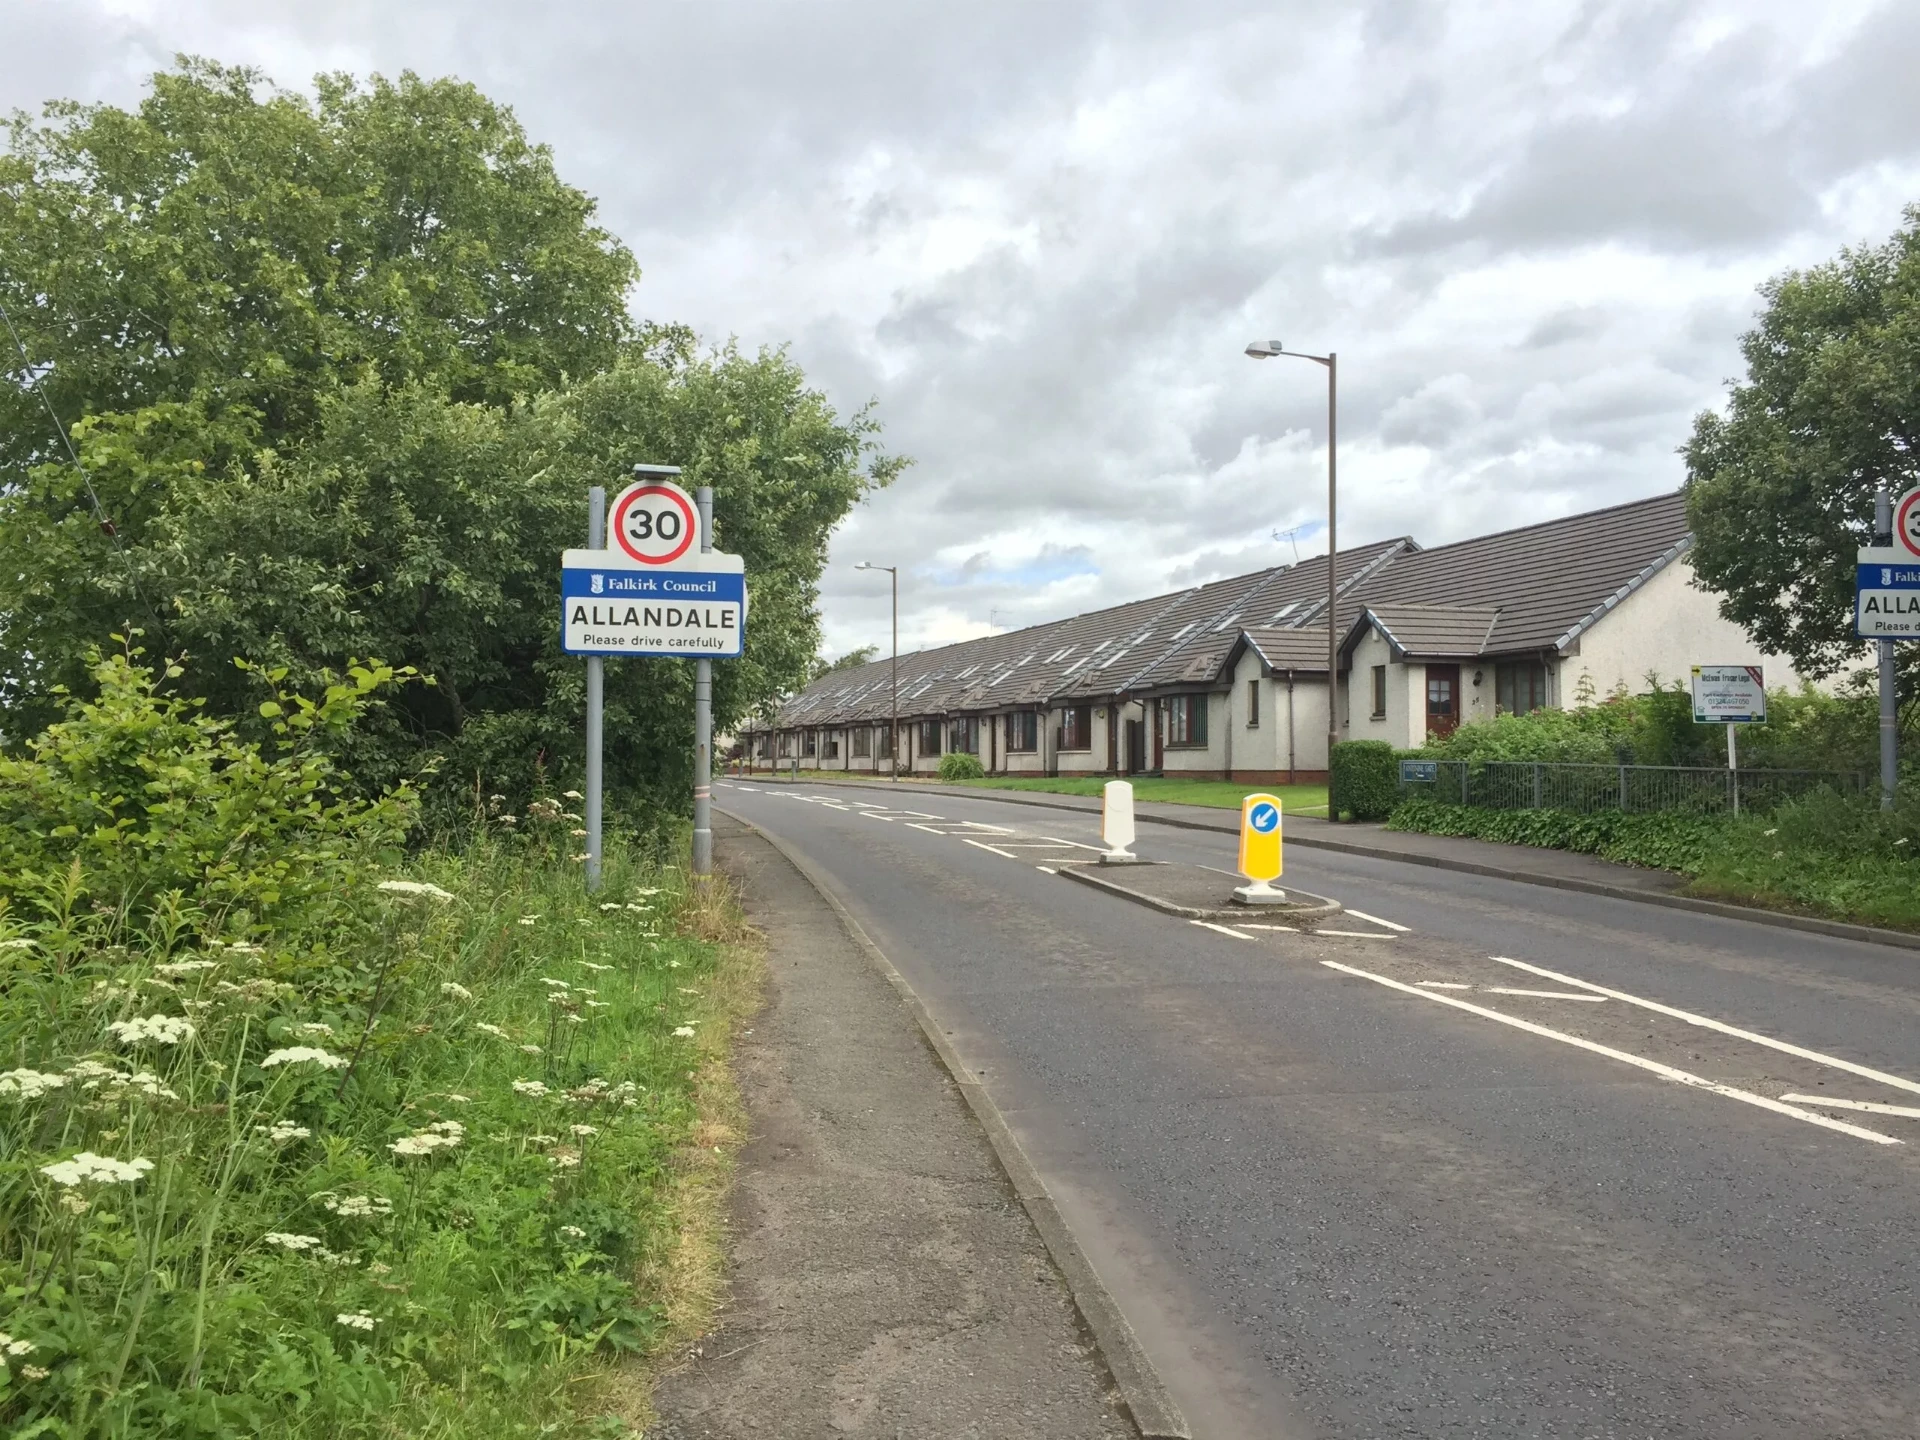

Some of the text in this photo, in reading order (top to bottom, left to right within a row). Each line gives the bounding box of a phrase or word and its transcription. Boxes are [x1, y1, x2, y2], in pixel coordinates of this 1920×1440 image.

[629, 509, 681, 541] 30
[608, 577, 717, 593] Falkirk Council
[570, 605, 735, 629] ALLANDALE
[1875, 621, 1911, 631] Please
[583, 634, 724, 650] Please drive carefully
